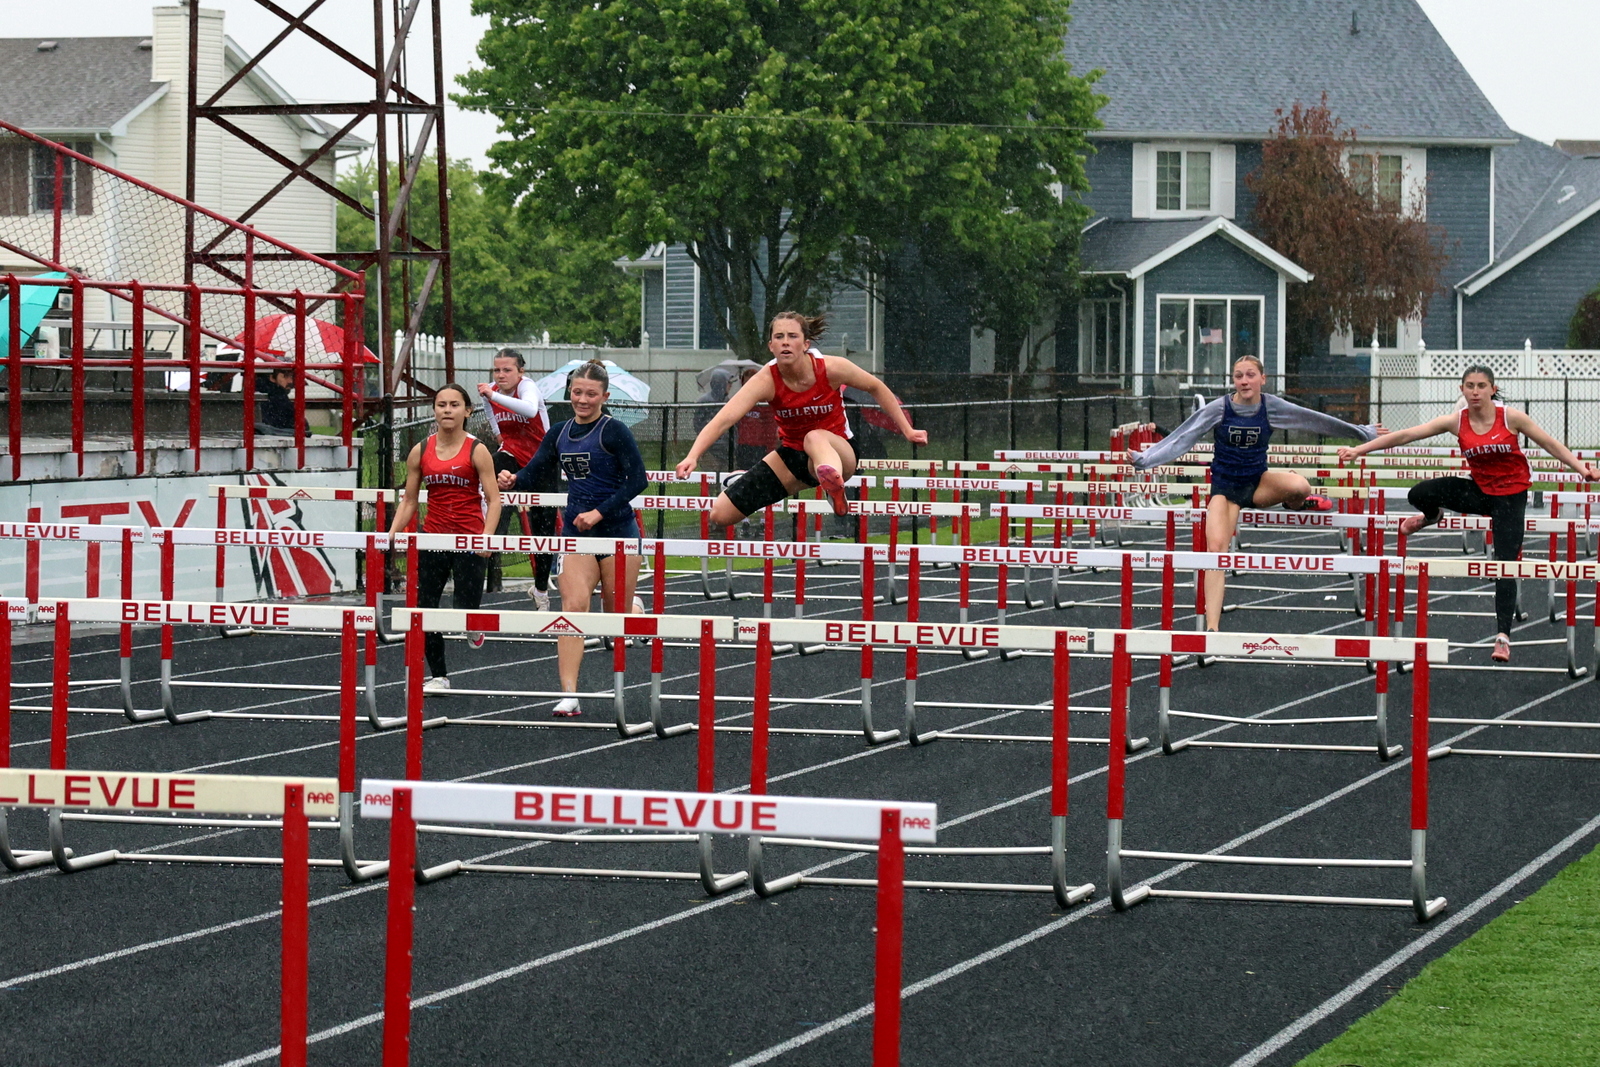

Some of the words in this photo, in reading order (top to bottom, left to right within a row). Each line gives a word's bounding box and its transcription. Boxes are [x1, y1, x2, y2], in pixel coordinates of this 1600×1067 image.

[495, 411, 530, 424] ELLEVUE
[1025, 452, 1080, 460] BELLEVUE
[1271, 446, 1324, 454] BELLEVUE
[1463, 444, 1512, 458] ELLEVUE
[860, 461, 909, 469] LLEVUE
[1269, 455, 1321, 464] ELLEVUE
[1384, 458, 1444, 467] BELLEVUE
[423, 473, 470, 487] ELLEVUE
[926, 479, 999, 490] BELLEVUE
[1538, 474, 1584, 483] BELLEV
[1088, 483, 1168, 494] BELLEVUE
[500, 494, 540, 505] EVUE
[644, 497, 713, 509] BELLEV
[848, 502, 932, 515] ELLEVUE
[1043, 506, 1133, 519] BELLEVUE
[1242, 513, 1333, 526] BELLEVUE
[0, 524, 80, 539] LLEVUE
[215, 530, 324, 546] BELLEVUE
[455, 535, 577, 552] BELLEVUE
[707, 541, 821, 558] BELLEVUE
[963, 547, 1078, 564] BELLEVUE
[1217, 555, 1334, 571] BELLEVUE
[1468, 562, 1596, 579] BELLEVUE
[121, 602, 289, 625] BELLEVUE
[825, 622, 999, 646] BELLEVUE
[0, 774, 196, 810] LEVUE
[514, 790, 777, 832] BELLEVUE
